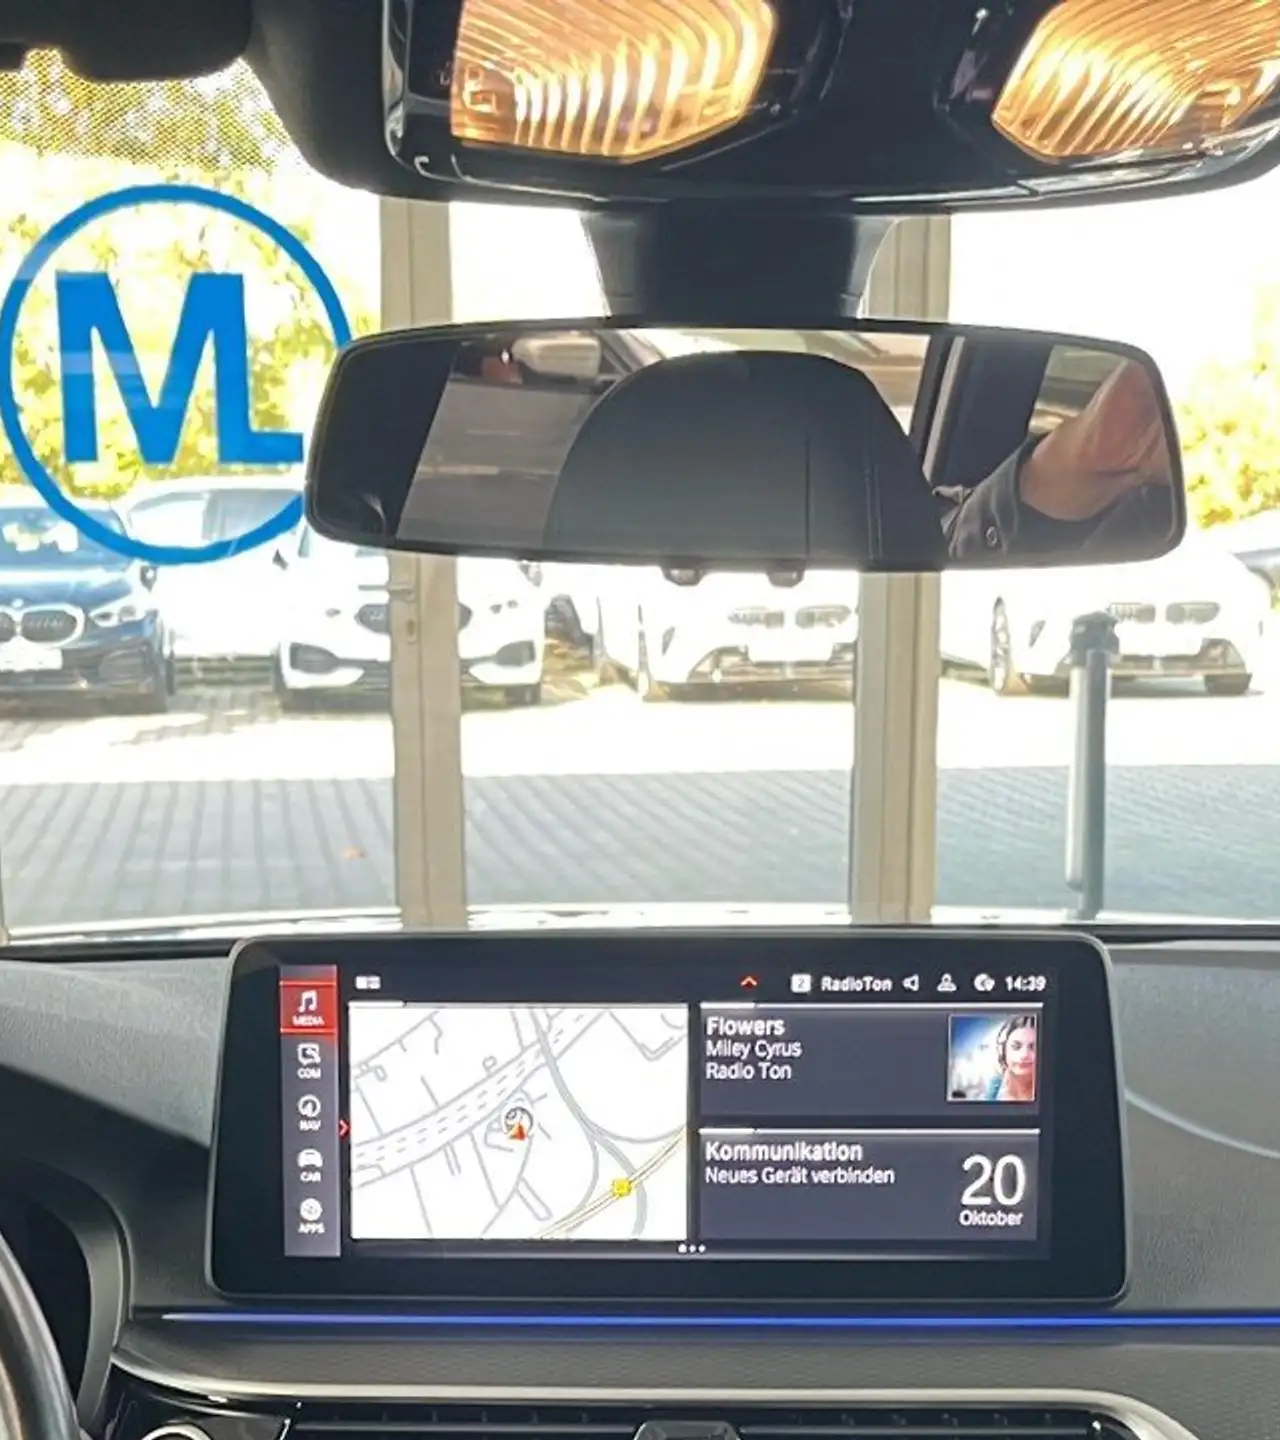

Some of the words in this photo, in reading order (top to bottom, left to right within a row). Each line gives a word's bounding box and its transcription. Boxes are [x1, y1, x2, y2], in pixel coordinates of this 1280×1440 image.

[54, 271, 304, 465] ML
[1005, 975, 1047, 992] 14:39
[292, 1014, 324, 1027] MEDIA
[706, 1016, 785, 1036] Flowers
[706, 1039, 751, 1059] Miley
[754, 1039, 803, 1060] Cyrus
[297, 1067, 321, 1079] COM
[706, 1062, 755, 1080] Radio
[758, 1062, 793, 1080] Ton
[299, 1119, 321, 1132] NAV
[705, 1141, 863, 1161] Kommunikation
[299, 1170, 321, 1182] CAR
[705, 1167, 759, 1184] Neues
[762, 1166, 808, 1184] Gerät
[810, 1167, 895, 1184] verbinden
[960, 1154, 1026, 1206] 20
[959, 1210, 1024, 1226] Oktober
[298, 1222, 325, 1234] APPS
